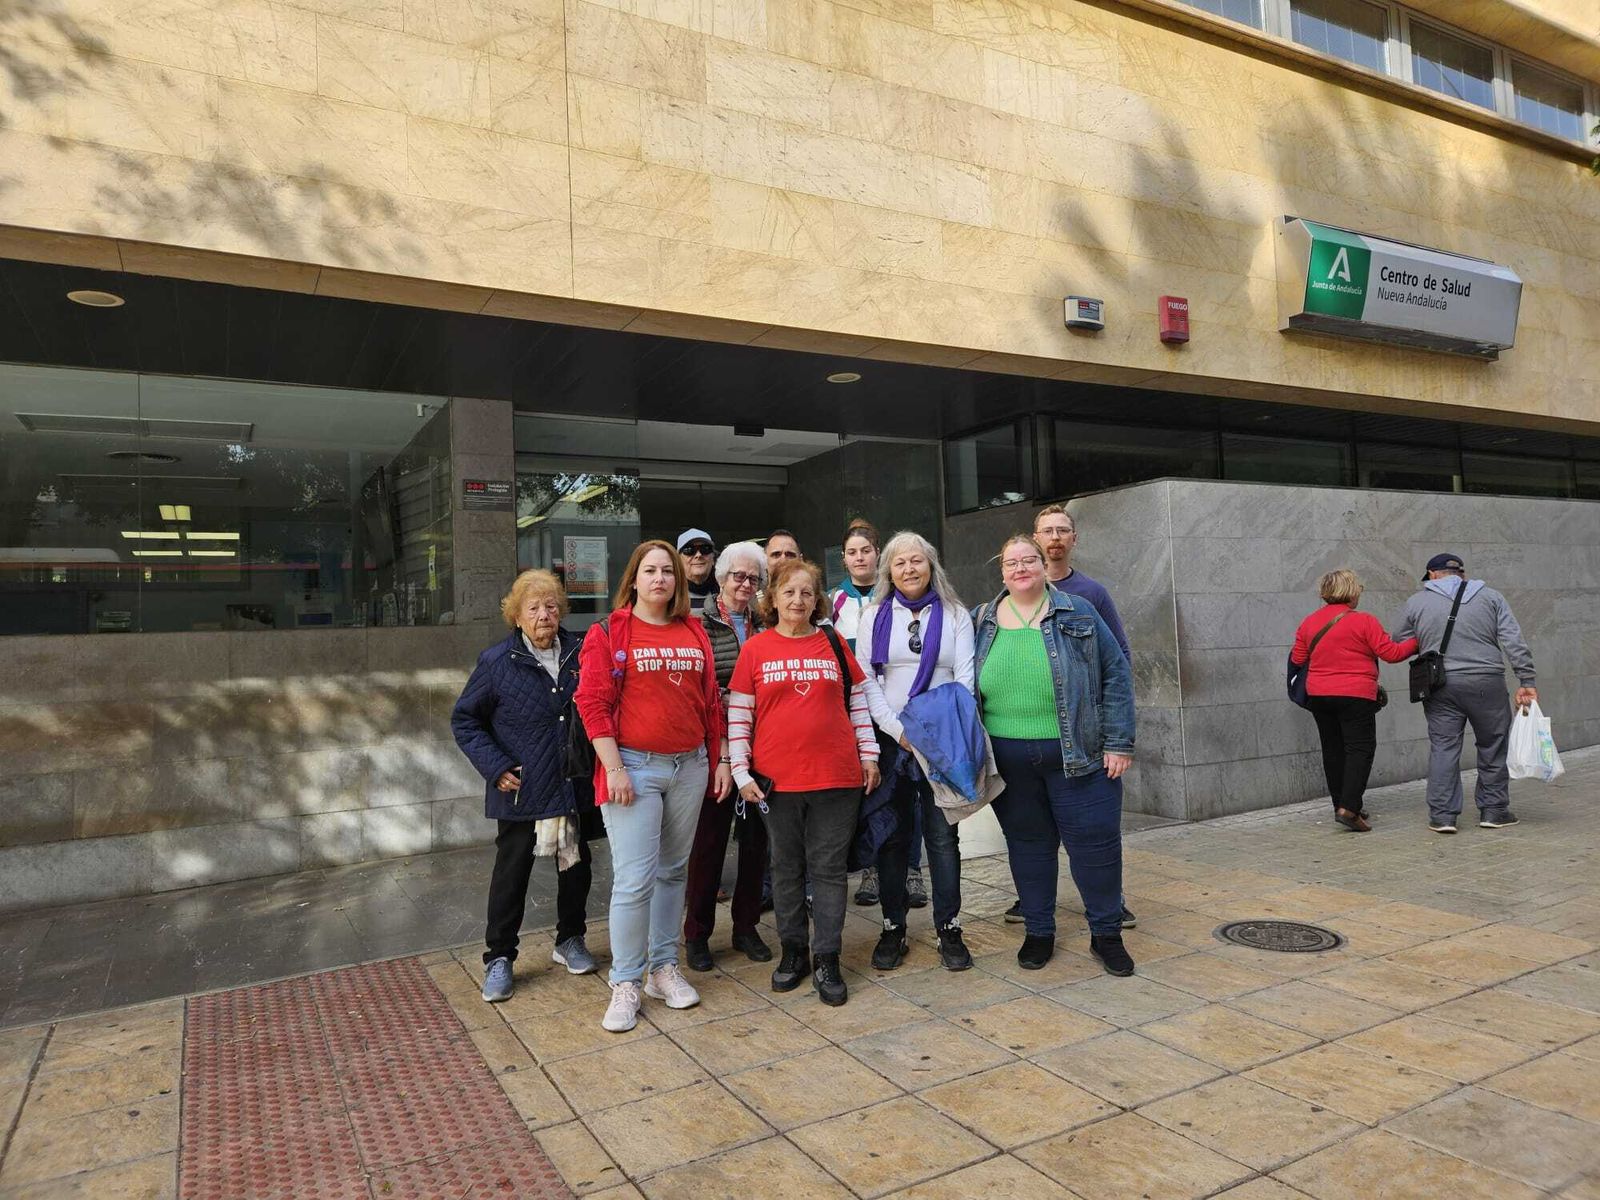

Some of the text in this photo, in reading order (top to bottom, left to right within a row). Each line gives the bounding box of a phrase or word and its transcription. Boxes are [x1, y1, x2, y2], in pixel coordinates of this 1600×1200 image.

[1312, 280, 1363, 295] Junta de Andalucía
[1380, 266, 1472, 297] Centro de Salud
[1167, 301, 1188, 311] FUEGO
[1377, 287, 1448, 311] Nueva Andalucía
[632, 648, 658, 660] IZAN
[659, 648, 674, 658] NO
[636, 660, 663, 672] STOP
[665, 659, 692, 671] Falso
[762, 660, 784, 673] IZAN
[787, 659, 800, 669] NO
[763, 670, 788, 684] STOP
[790, 670, 820, 681] Falso
